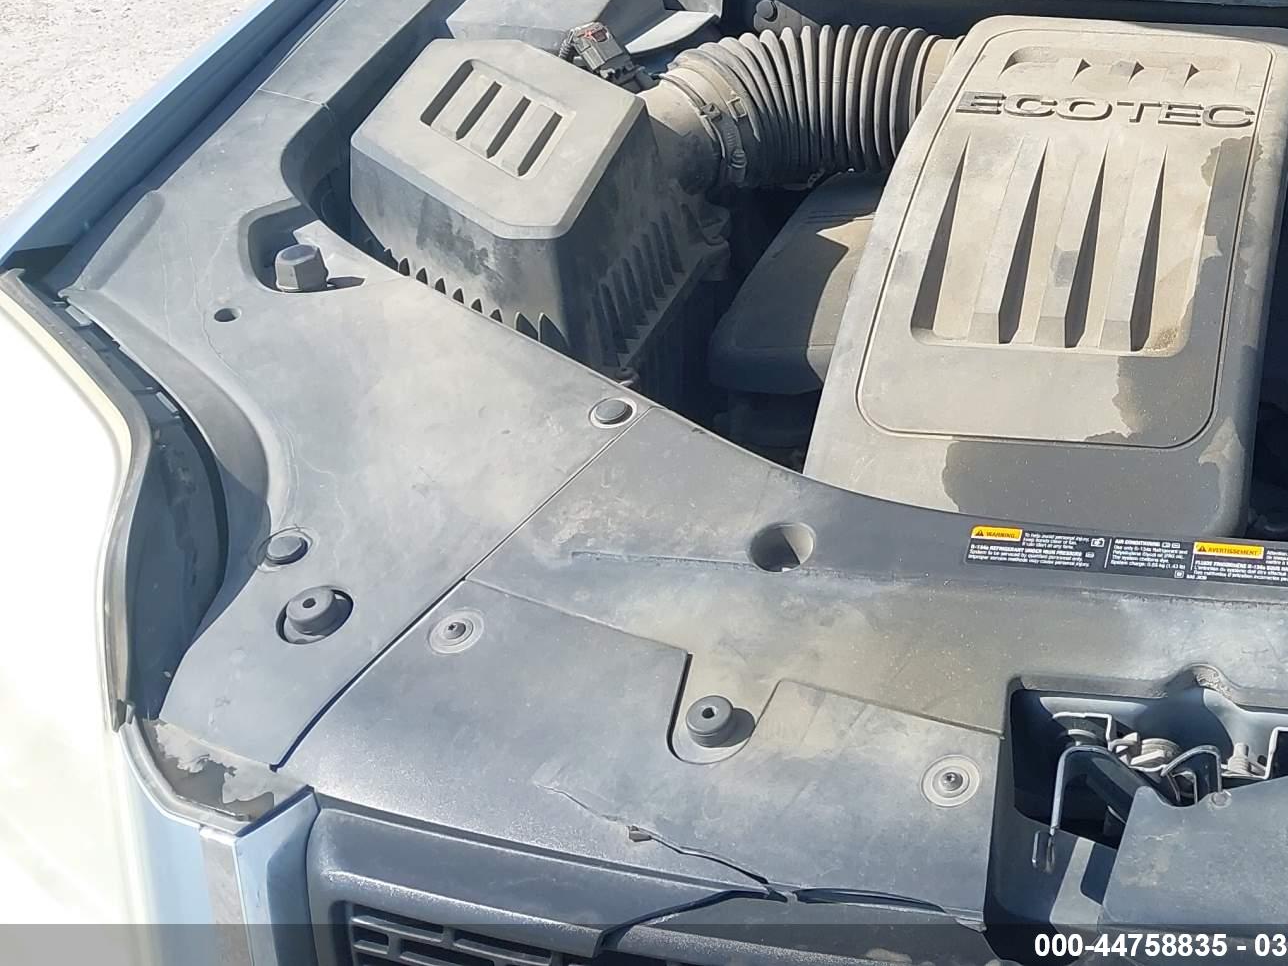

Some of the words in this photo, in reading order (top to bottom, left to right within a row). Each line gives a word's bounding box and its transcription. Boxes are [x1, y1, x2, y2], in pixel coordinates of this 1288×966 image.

[955, 90, 1255, 128] ECOTEC
[986, 531, 1016, 539] WARNING
[1208, 547, 1257, 556] AVERTISSEMENT
